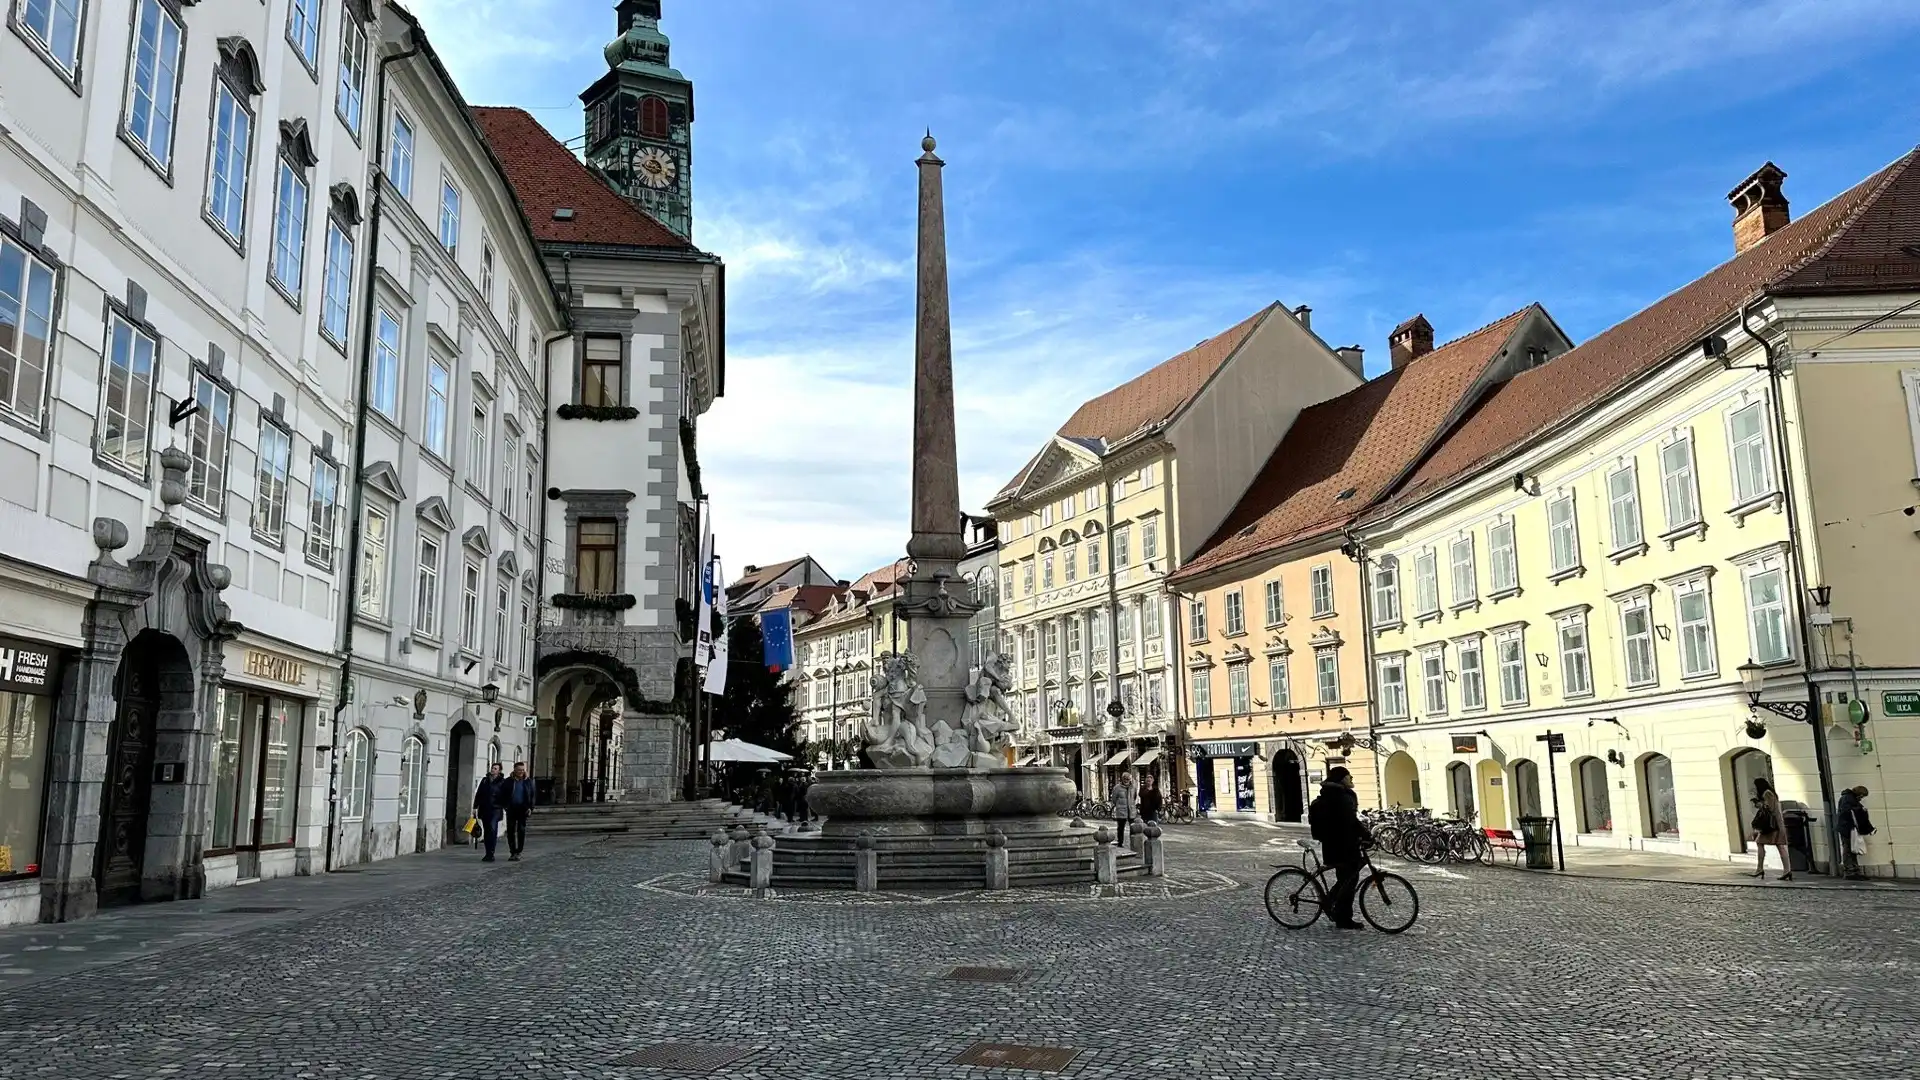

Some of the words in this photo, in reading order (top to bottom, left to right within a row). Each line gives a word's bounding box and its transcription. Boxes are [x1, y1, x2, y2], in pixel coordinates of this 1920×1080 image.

[17, 650, 49, 668] FRESH
[16, 665, 46, 677] HANDMADE
[14, 674, 45, 685] COSMETICS
[1896, 704, 1912, 712] ULICA
[1207, 743, 1236, 755] FOOTBALL
